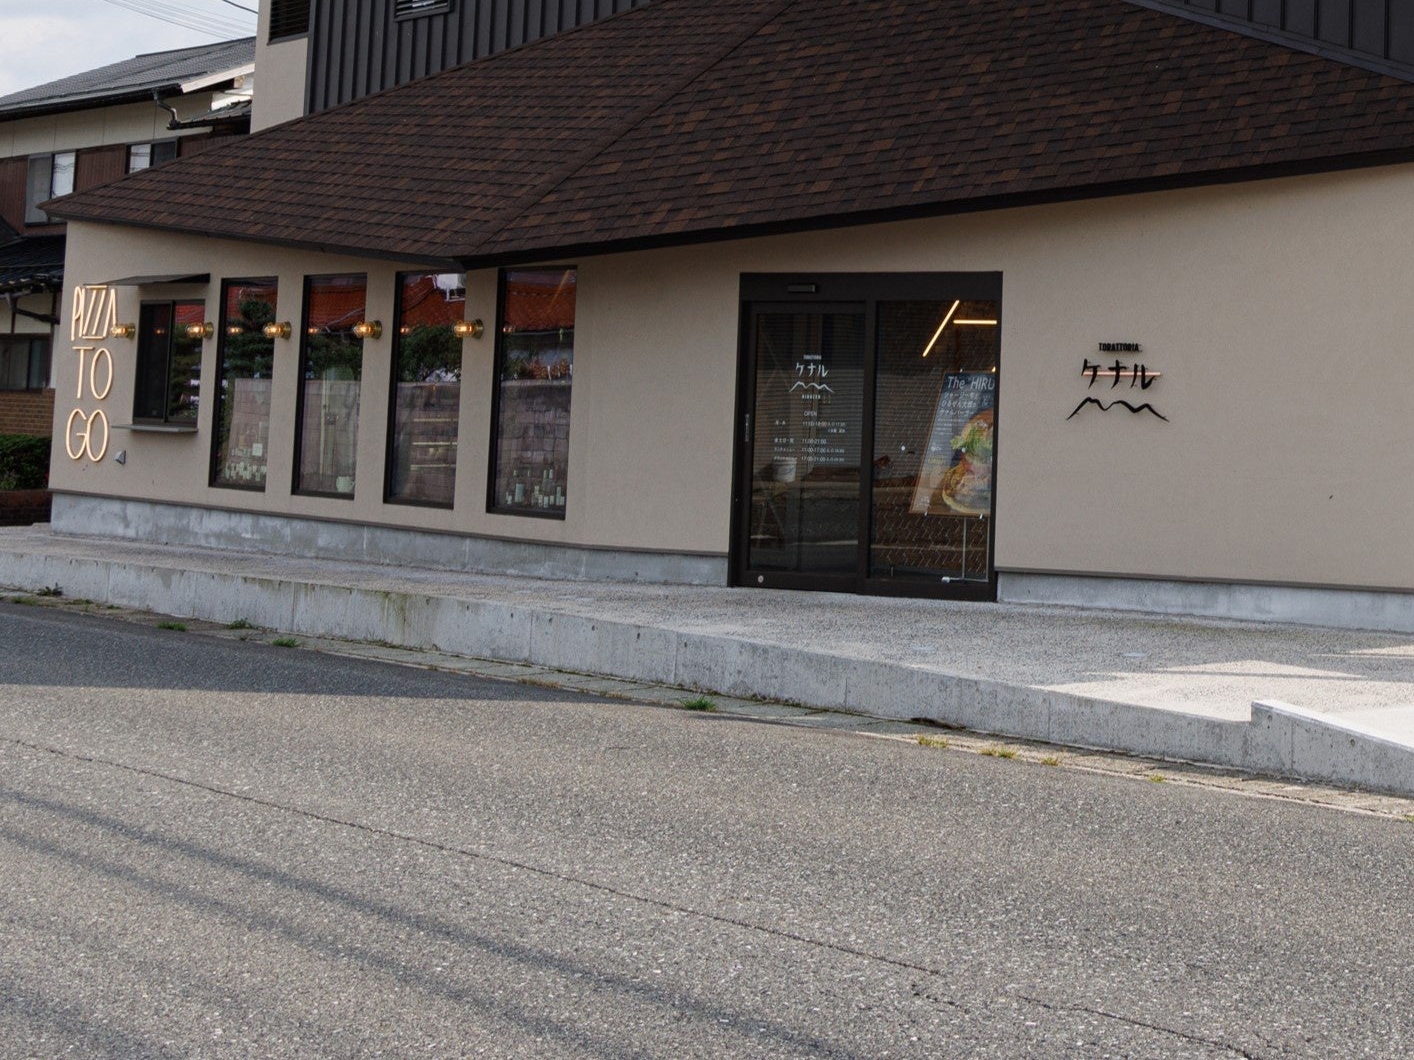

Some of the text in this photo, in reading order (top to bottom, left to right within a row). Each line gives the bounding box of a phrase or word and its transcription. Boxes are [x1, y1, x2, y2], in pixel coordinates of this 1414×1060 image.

[71, 285, 117, 341] PIZZA
[1099, 342, 1140, 352] TORATTORIA
[72, 347, 113, 399] TO
[795, 362, 829, 377] ケナル
[948, 376, 965, 389] The
[1081, 358, 1156, 390] ケナル
[66, 408, 108, 461] GO
